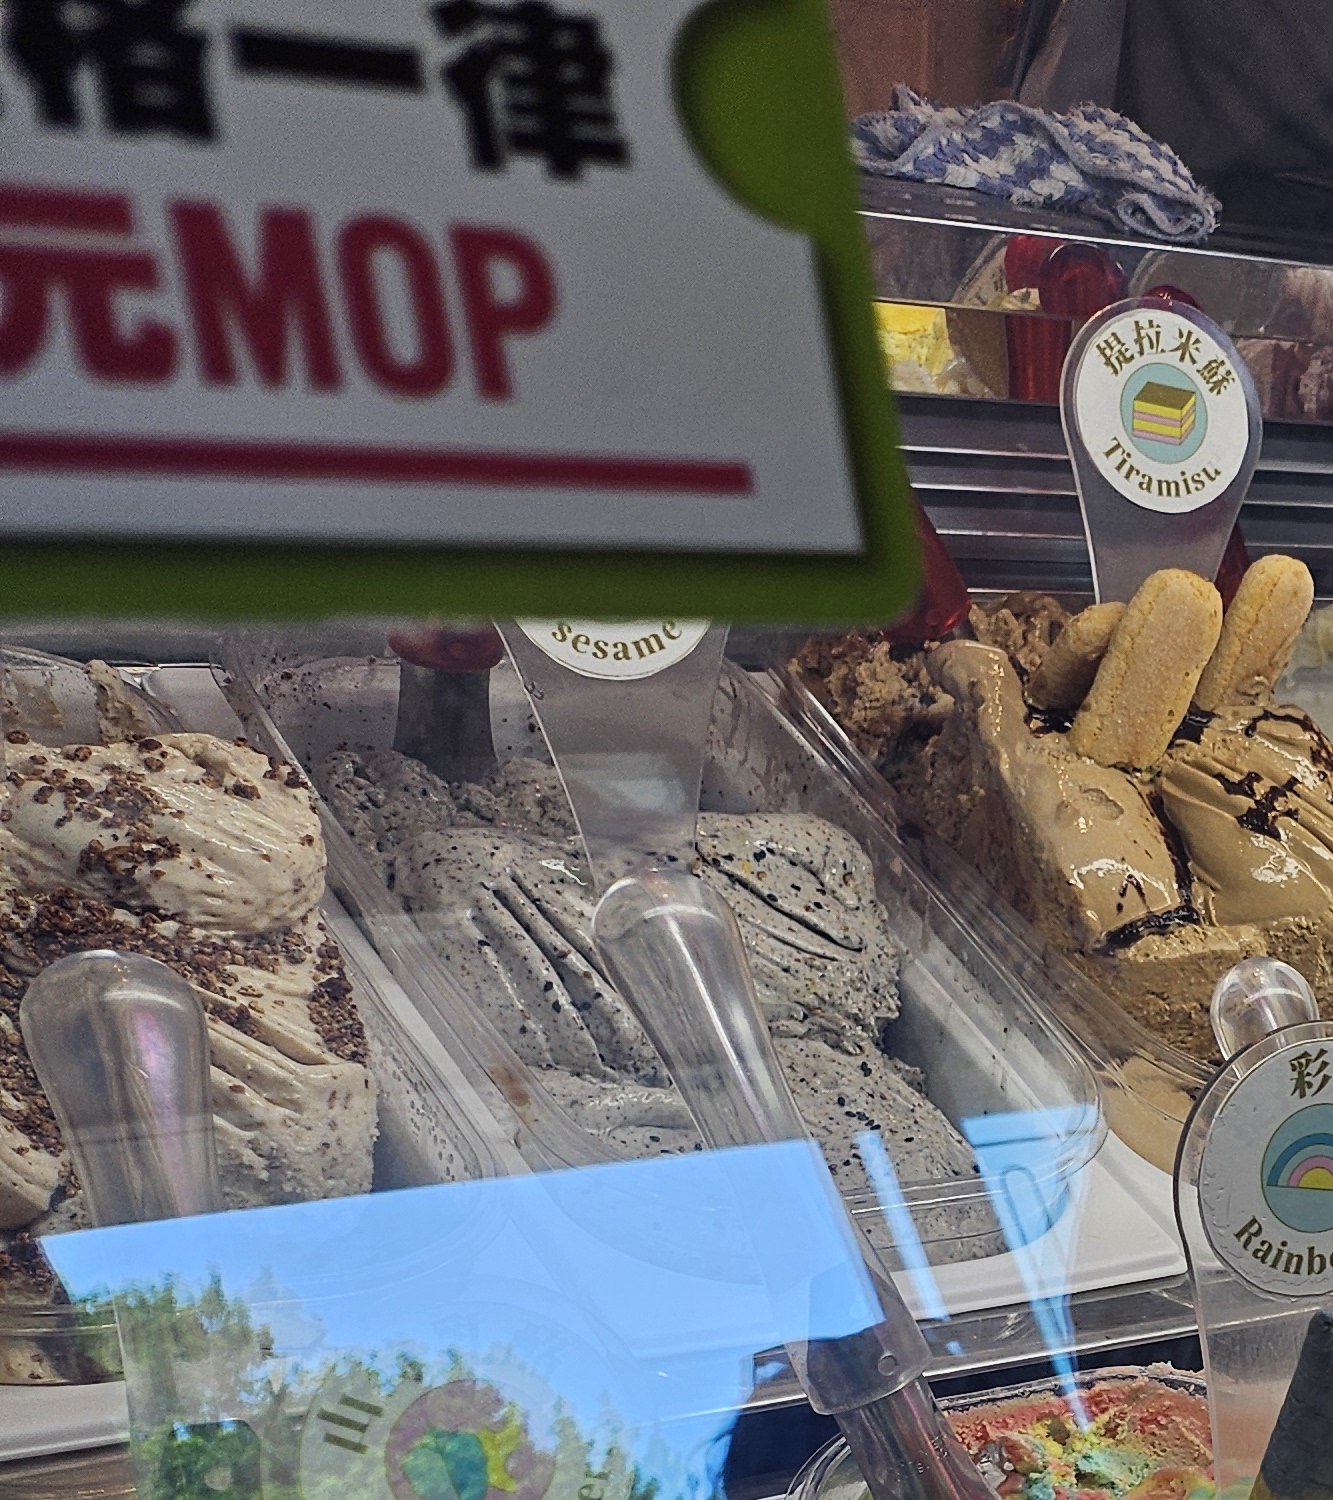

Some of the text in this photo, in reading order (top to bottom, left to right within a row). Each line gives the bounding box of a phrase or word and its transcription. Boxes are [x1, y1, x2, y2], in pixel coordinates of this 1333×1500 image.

[1095, 318, 1236, 397] 提拉米蘇
[1102, 436, 1223, 498] Tiramisu
